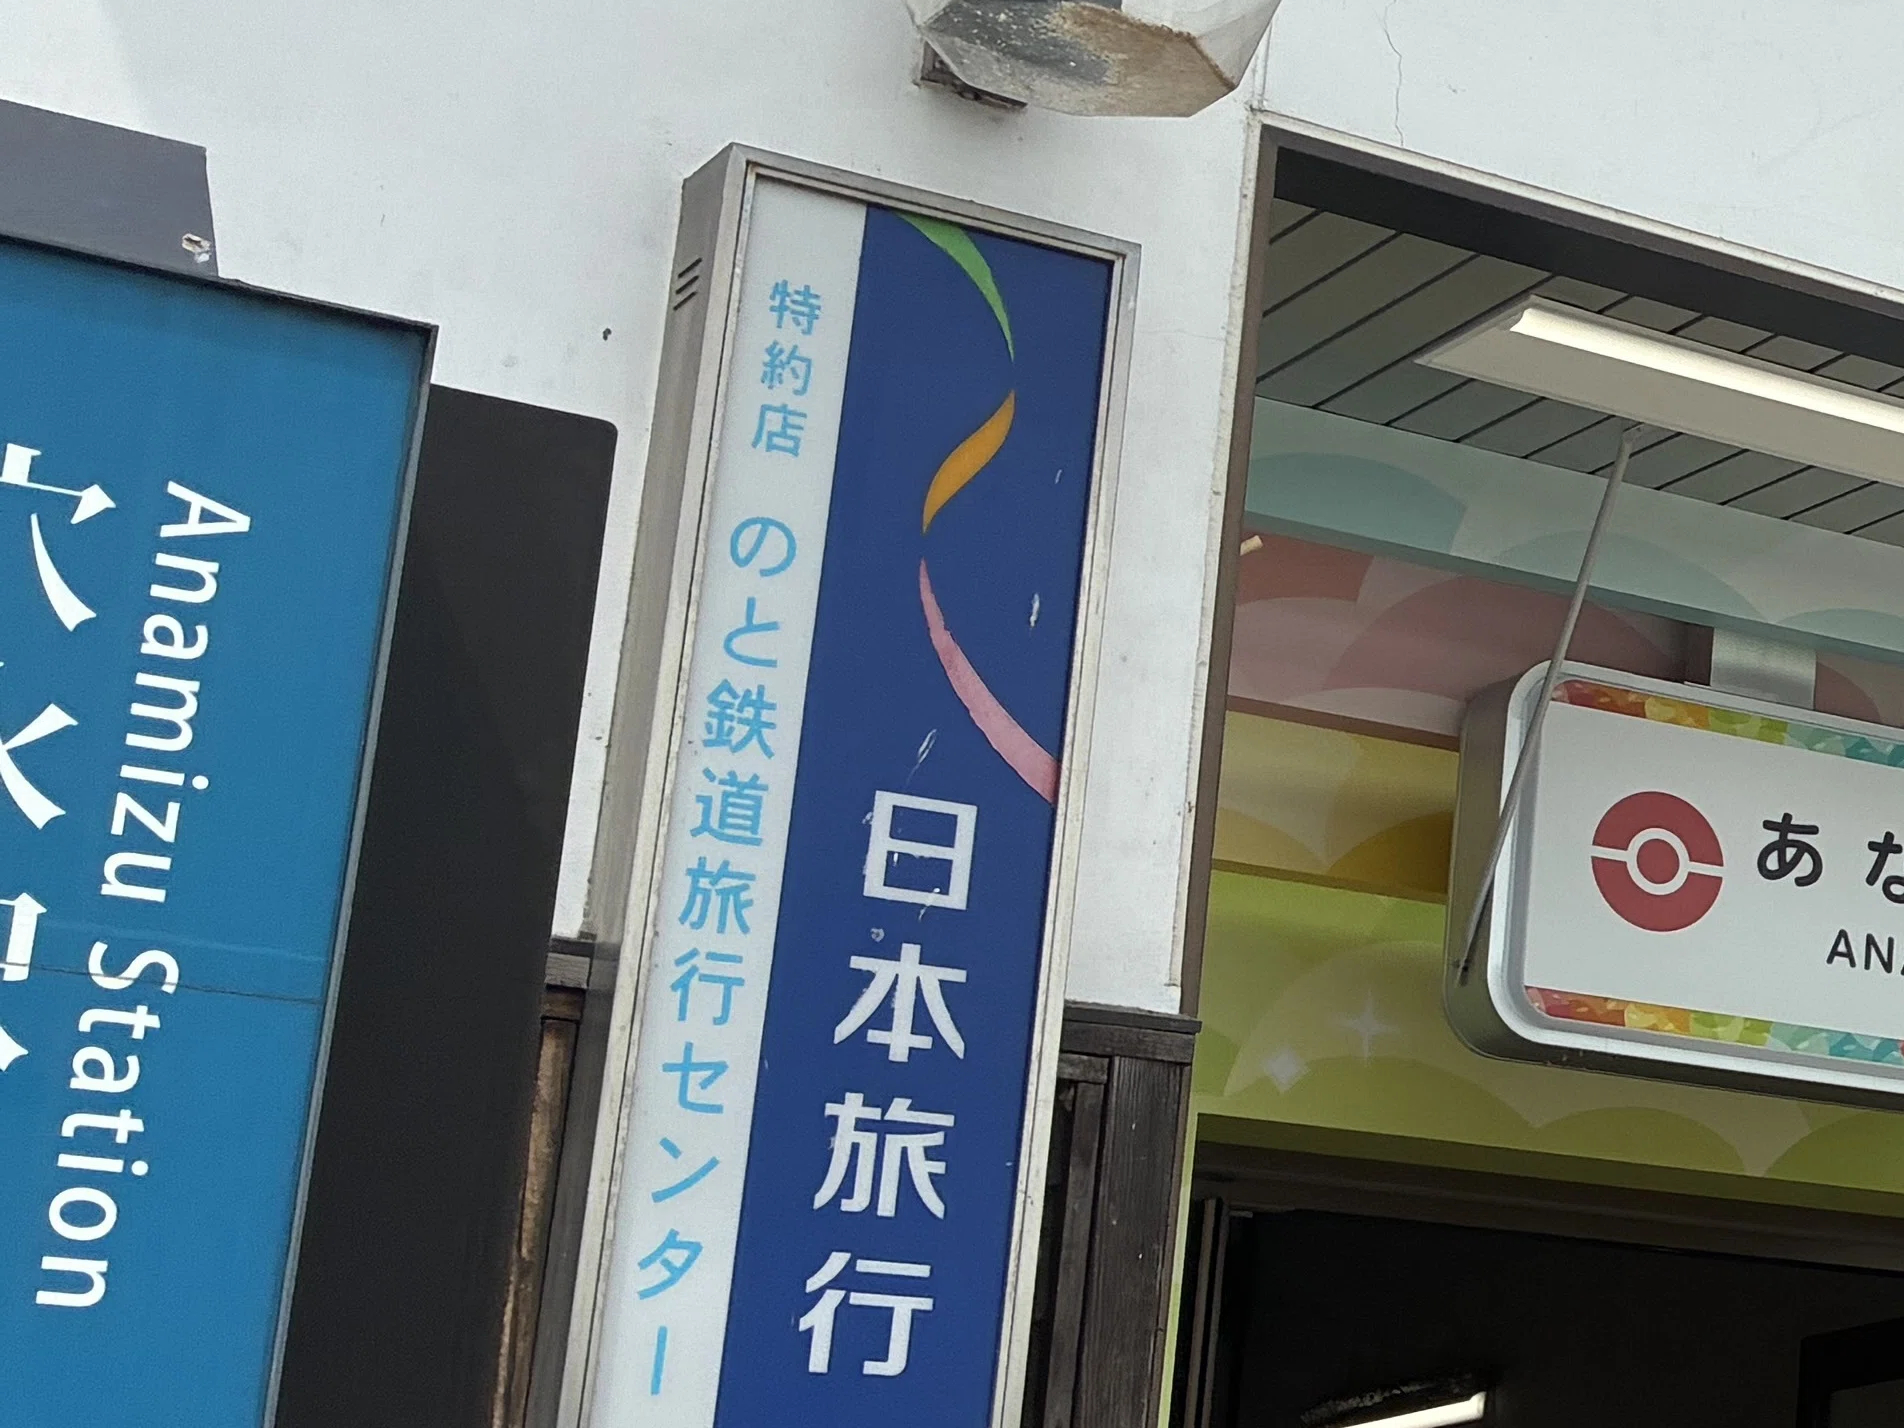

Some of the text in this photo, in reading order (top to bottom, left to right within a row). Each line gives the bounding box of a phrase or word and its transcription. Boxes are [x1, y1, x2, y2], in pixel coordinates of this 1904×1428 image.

[100, 479, 251, 903] Anamizu
[638, 279, 822, 1396] 特約店 のと鉄道旅行センター
[35, 941, 180, 1308] Station
[798, 788, 978, 1378] 日本旅行
